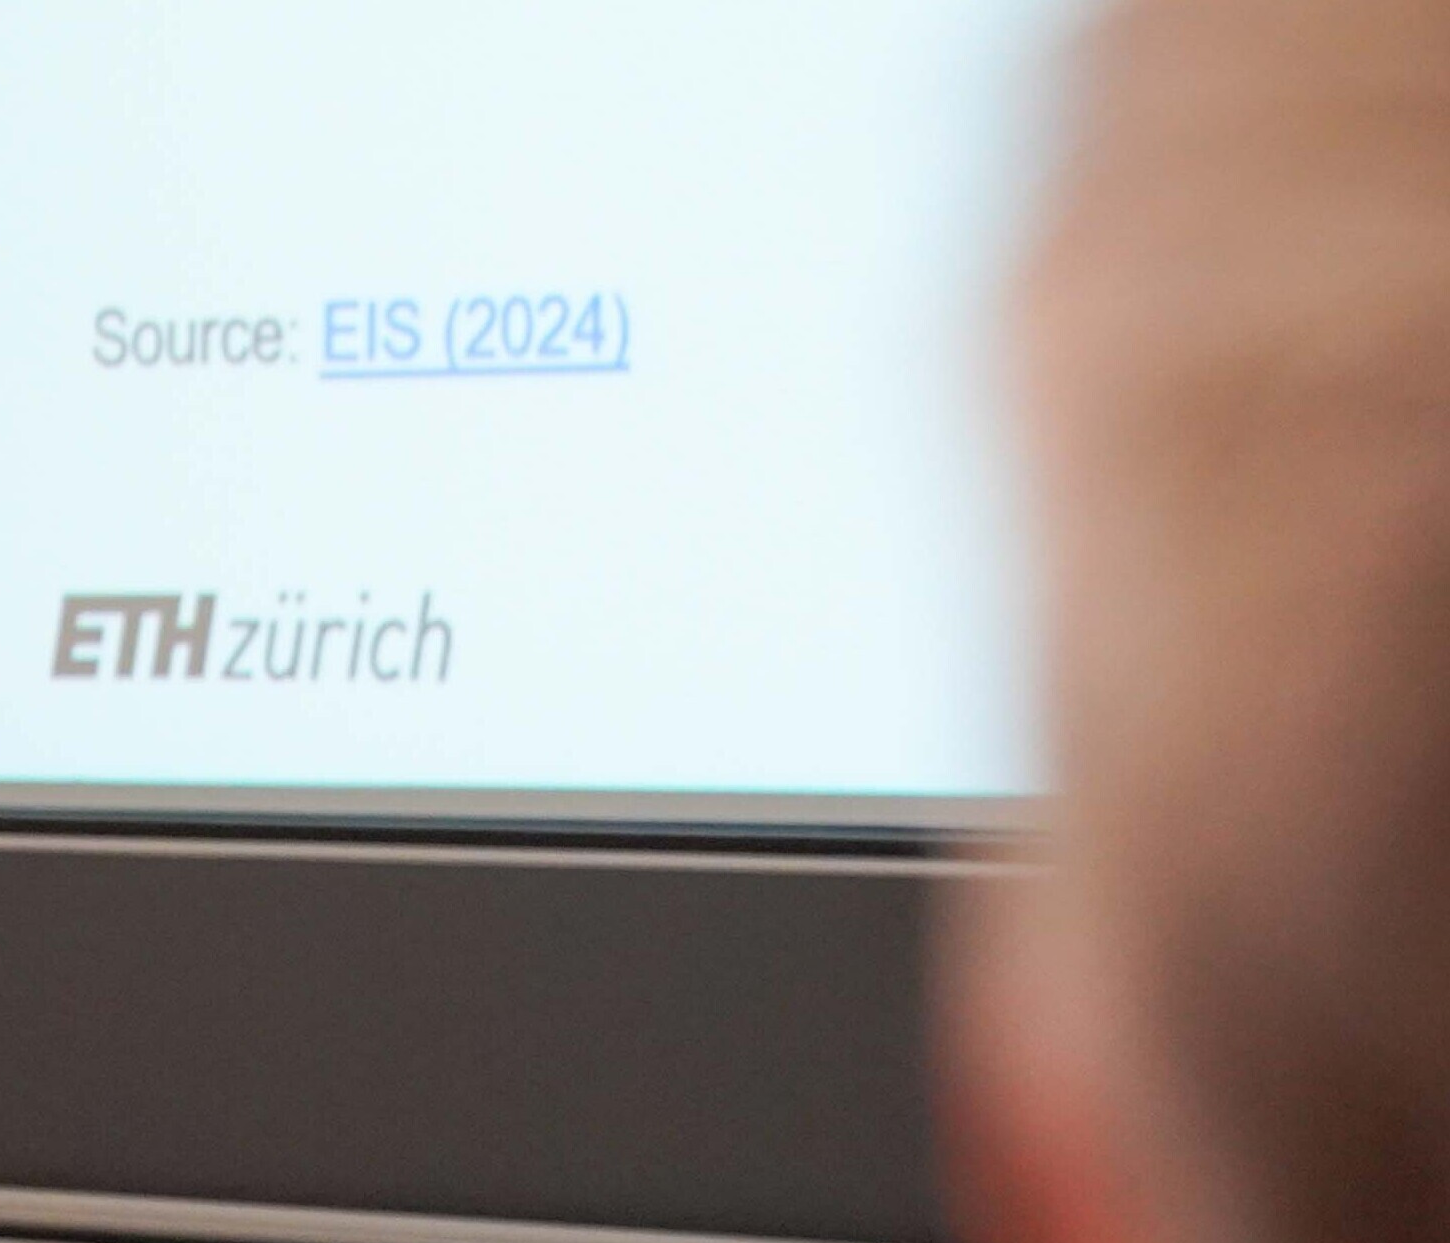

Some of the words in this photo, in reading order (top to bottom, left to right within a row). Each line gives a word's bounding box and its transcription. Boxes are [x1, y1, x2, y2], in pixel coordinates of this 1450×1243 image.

[93, 306, 299, 368] Source:
[322, 297, 422, 363] EIS
[444, 292, 630, 372] (2024)
